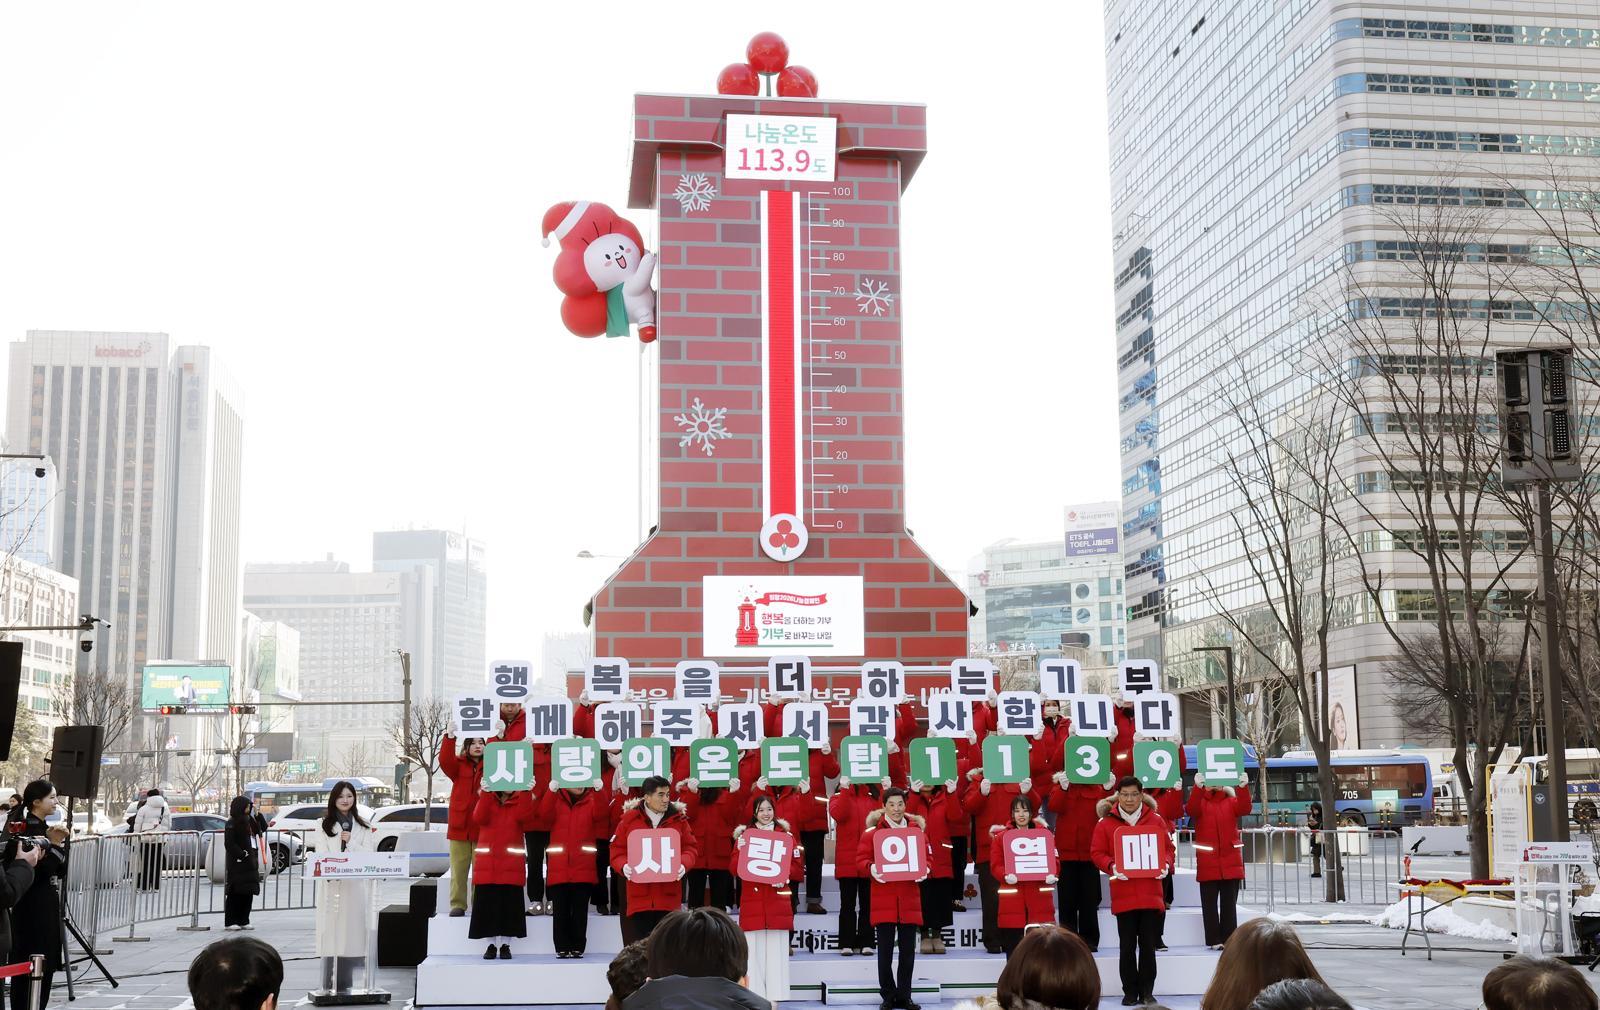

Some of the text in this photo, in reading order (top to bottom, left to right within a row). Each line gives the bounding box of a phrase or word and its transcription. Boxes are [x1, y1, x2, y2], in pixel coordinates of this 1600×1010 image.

[745, 122, 819, 144] 나눔온도
[832, 187, 851, 196] 100
[832, 219, 845, 228] 90
[833, 252, 845, 262] 80
[833, 286, 846, 295] 70
[833, 317, 846, 327] 60
[95, 345, 144, 358] kobaco
[834, 351, 846, 360] 50
[834, 385, 847, 394] 40
[835, 417, 848, 426] 30
[836, 451, 848, 460] 20
[837, 485, 849, 494] 10
[836, 521, 843, 530] 0
[1070, 541, 1092, 549] TOEFL
[762, 613, 832, 625] 행복을 더하는 기부
[762, 628, 832, 640] 기부로 바꾸는 내일
[1342, 791, 1359, 800] 705
